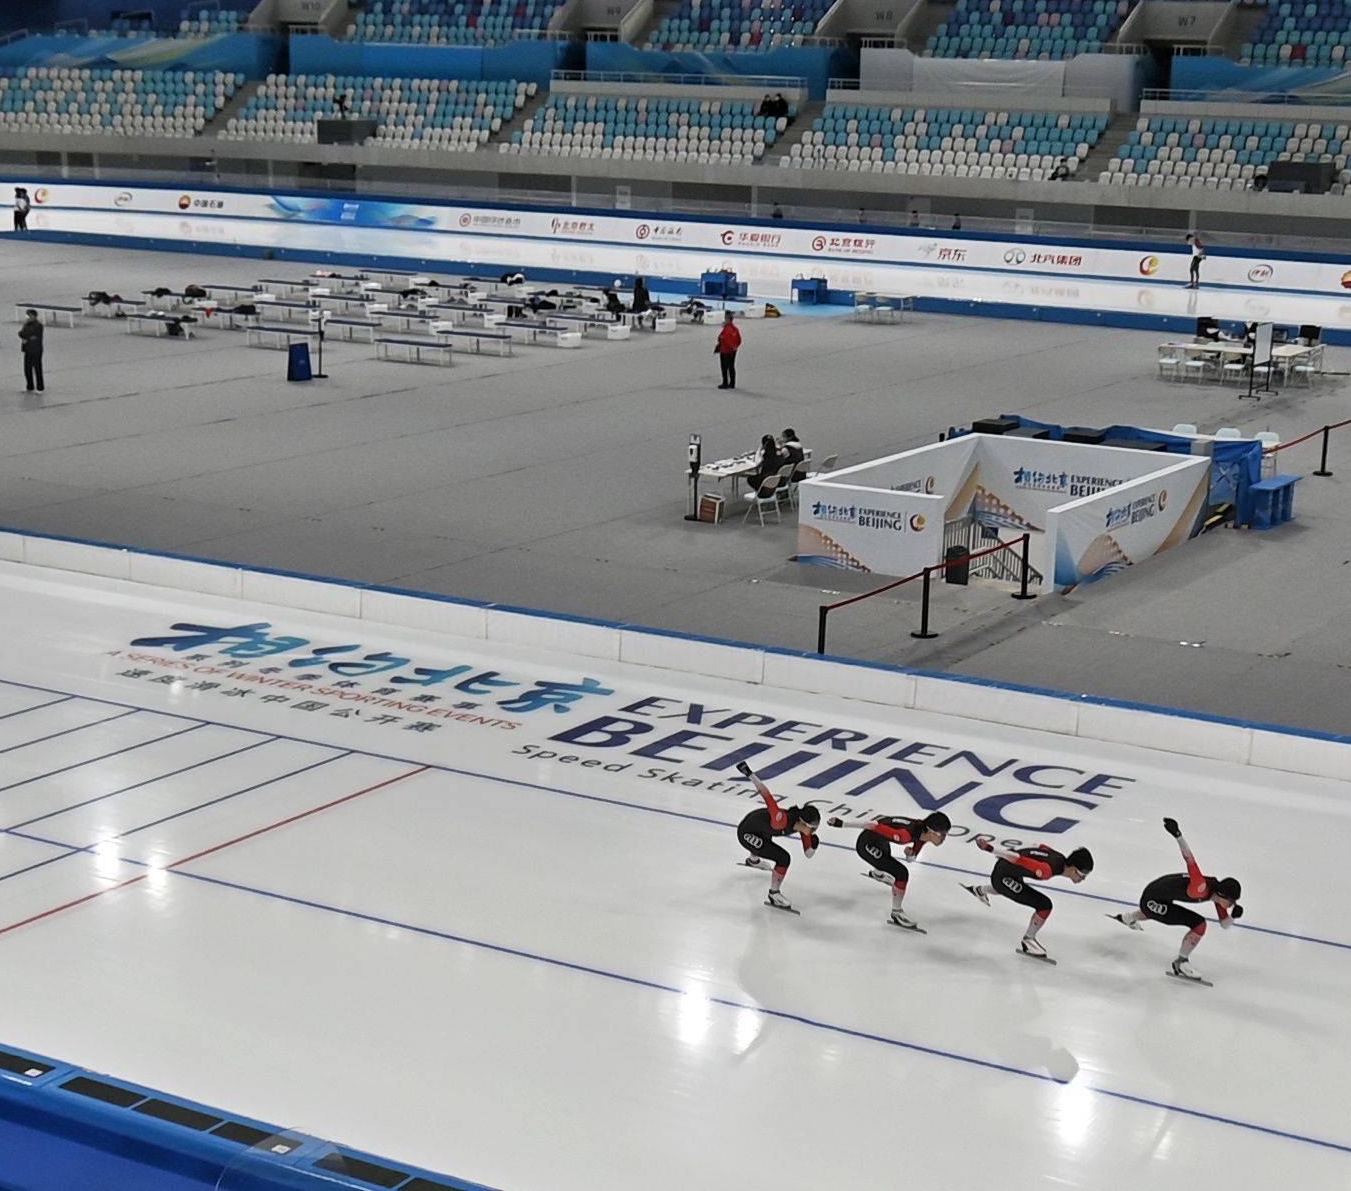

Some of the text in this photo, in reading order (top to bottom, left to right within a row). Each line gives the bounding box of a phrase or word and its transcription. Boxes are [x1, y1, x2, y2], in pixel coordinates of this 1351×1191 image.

[1177, 15, 1197, 27] W7
[935, 247, 967, 262] 京东
[1030, 252, 1082, 267] 北汽集团
[858, 507, 902, 520] EXPERIENCE
[858, 515, 903, 532] BEIJING
[127, 652, 195, 671] SERIES
[226, 671, 315, 692] WINTER
[310, 686, 429, 713] SPORTING
[426, 708, 525, 730] EVENTS
[616, 695, 1137, 799] EXPERIENCE
[546, 714, 1099, 835] BEIJING
[511, 744, 634, 774] Speed
[948, 824, 1023, 851] Ope
